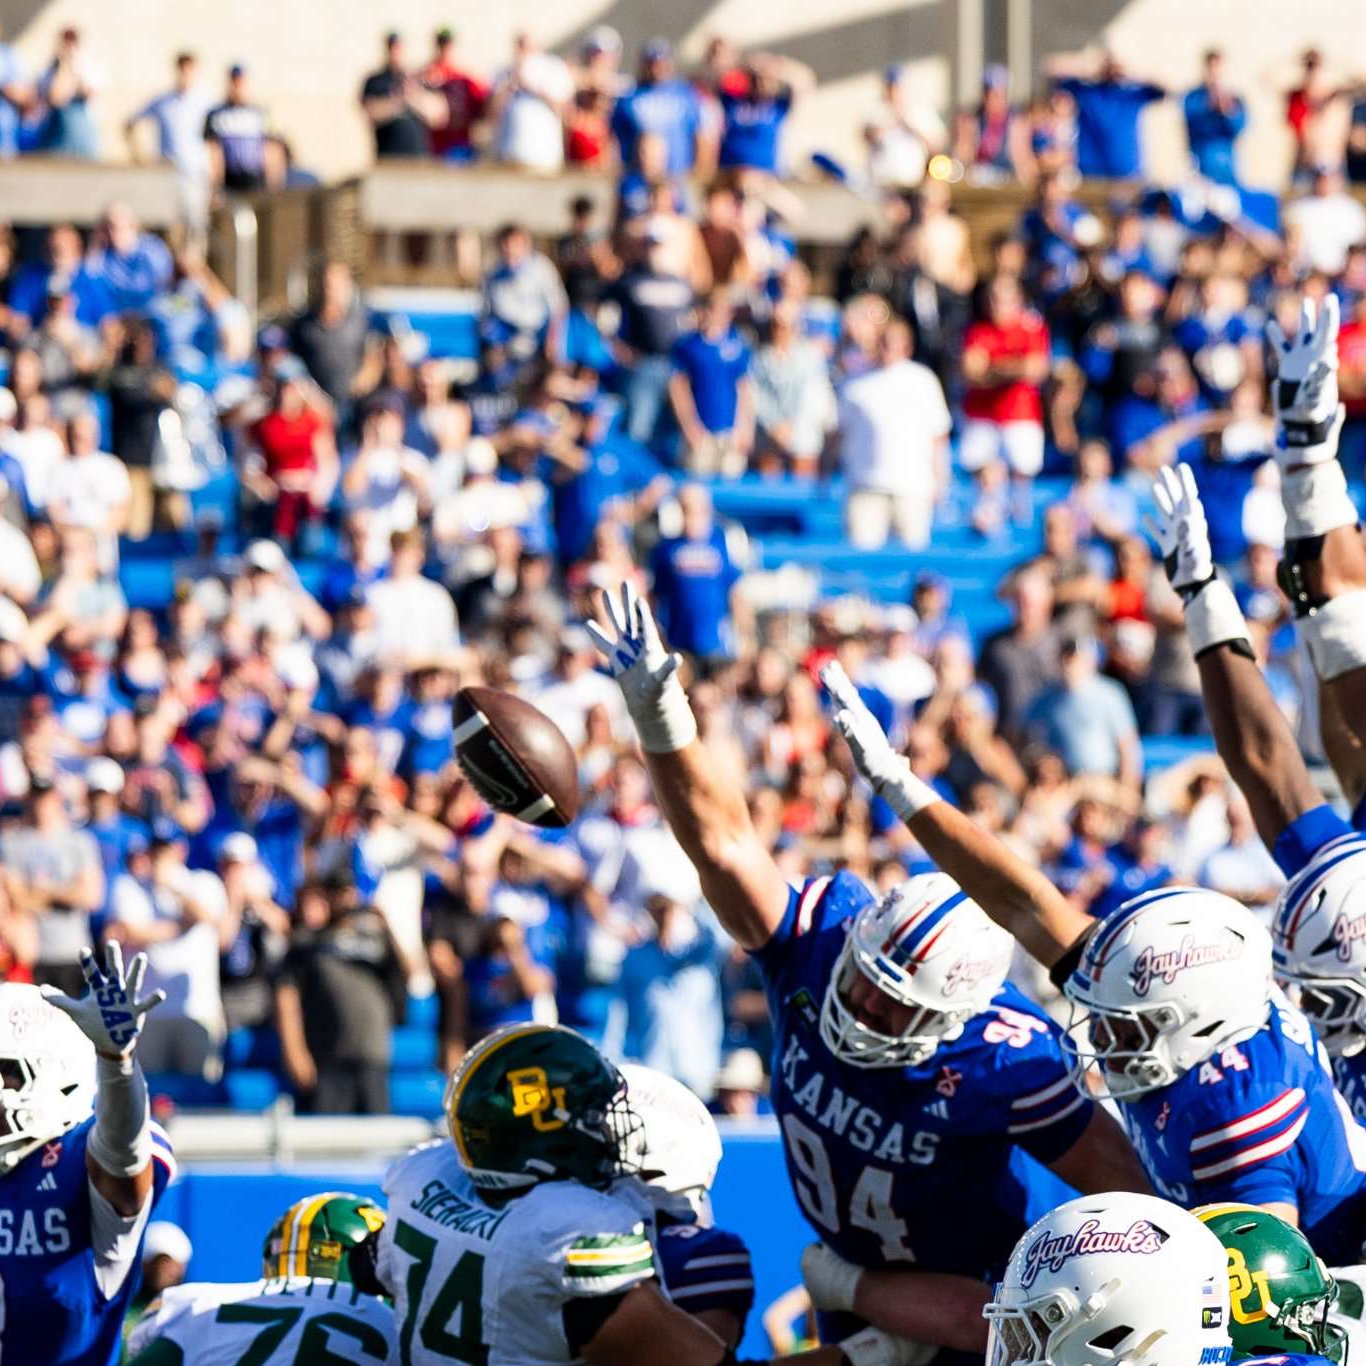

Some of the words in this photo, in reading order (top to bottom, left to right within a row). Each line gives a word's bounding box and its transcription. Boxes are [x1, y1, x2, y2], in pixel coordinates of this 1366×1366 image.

[781, 1034, 939, 1166] KANSAS
[1199, 1045, 1249, 1085] 44
[782, 1112, 916, 1263] 94
[1021, 1219, 1163, 1288] Jayhawks
